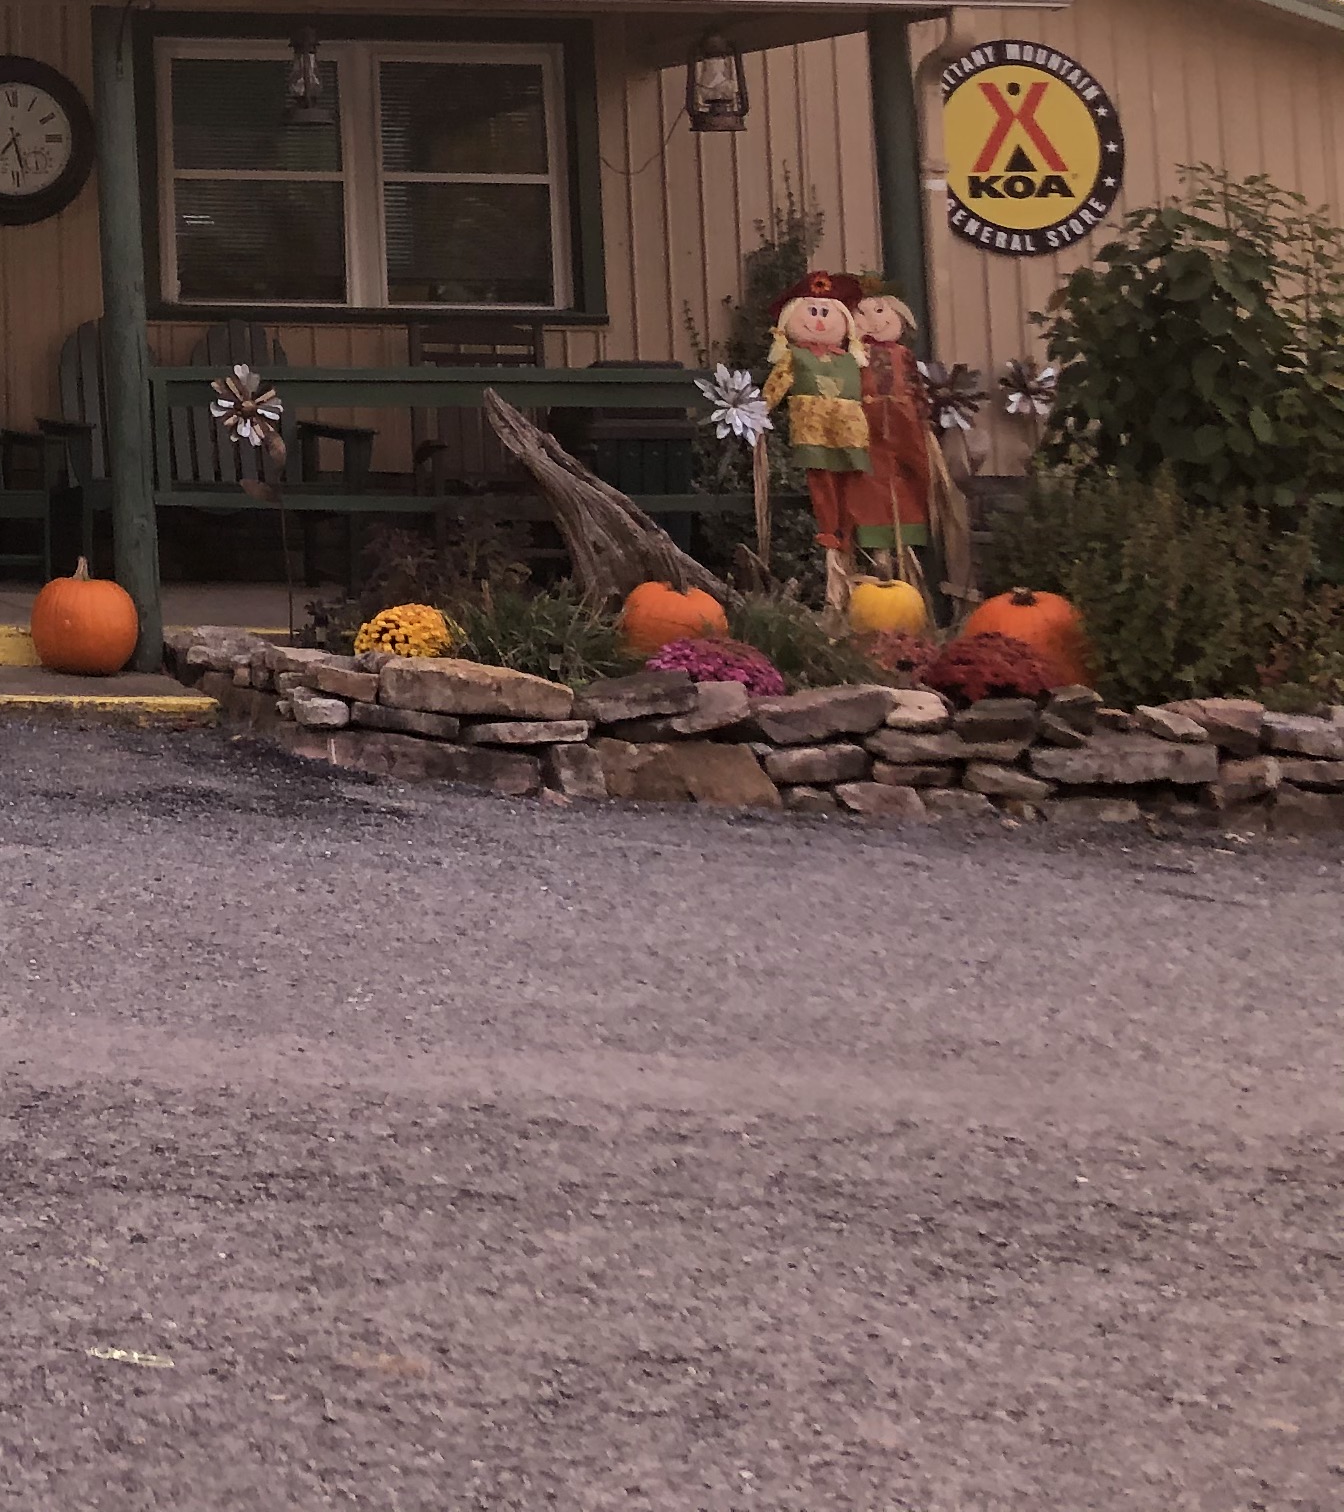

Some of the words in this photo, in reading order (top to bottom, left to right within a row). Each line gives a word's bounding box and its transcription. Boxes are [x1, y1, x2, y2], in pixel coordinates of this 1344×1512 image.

[940, 45, 996, 96] ITTANY
[1005, 43, 1101, 102] MOUNTAIN
[967, 175, 1076, 199] KOA
[1047, 197, 1107, 248] STORE
